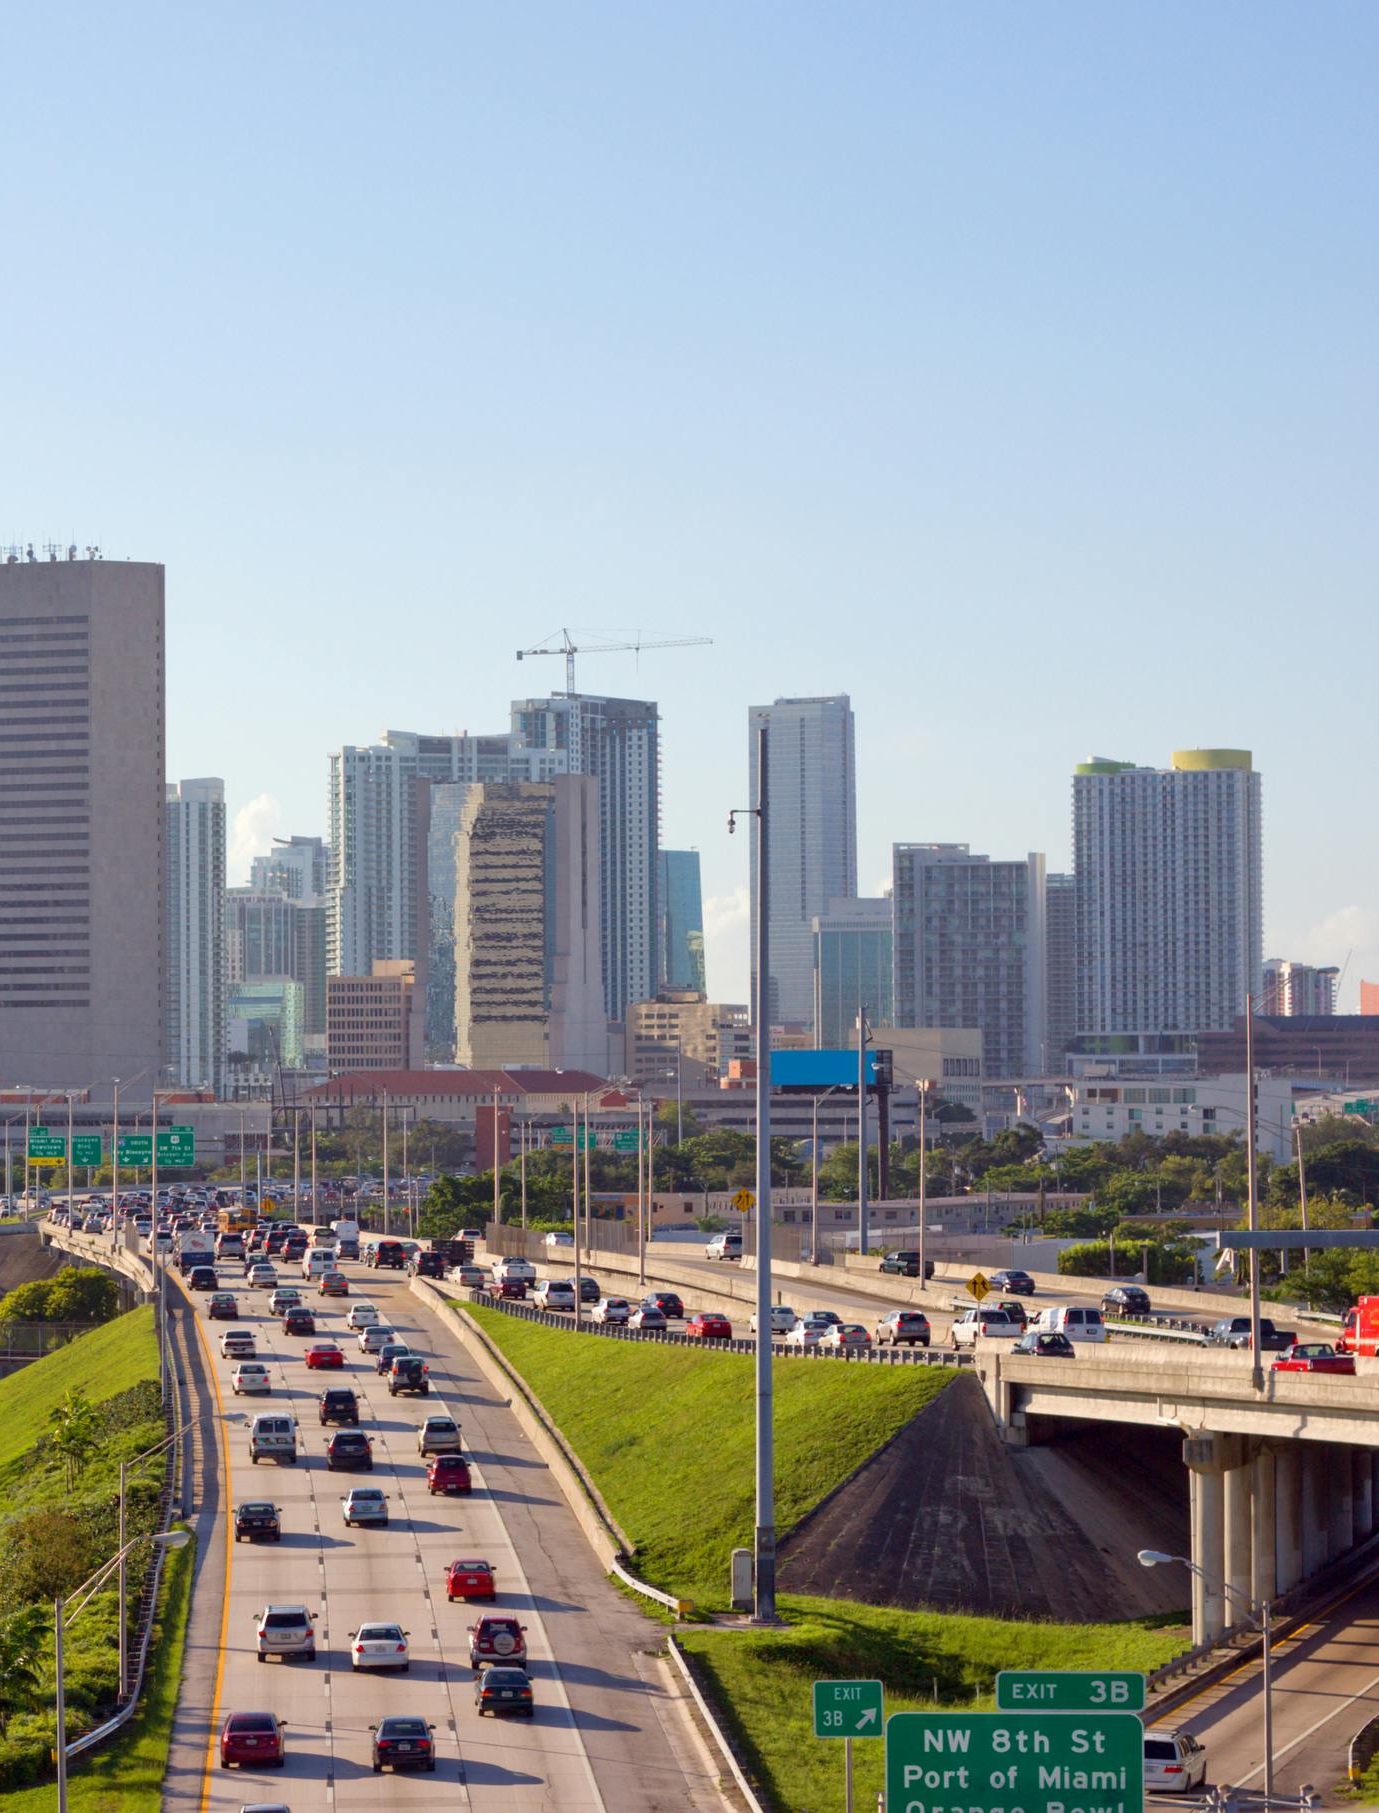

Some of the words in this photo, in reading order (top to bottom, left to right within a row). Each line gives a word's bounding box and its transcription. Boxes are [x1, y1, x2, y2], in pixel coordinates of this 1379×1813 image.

[834, 1687, 863, 1700] EXIT
[1011, 1683, 1058, 1699] EXIT
[1089, 1680, 1130, 1703] 3B
[823, 1710, 843, 1727] 3B
[924, 1729, 971, 1753] NW
[991, 1729, 1050, 1753] 8th
[1070, 1729, 1106, 1753] St
[903, 1765, 969, 1789] Port
[989, 1765, 1018, 1789] of
[1038, 1765, 1126, 1790] Miami
